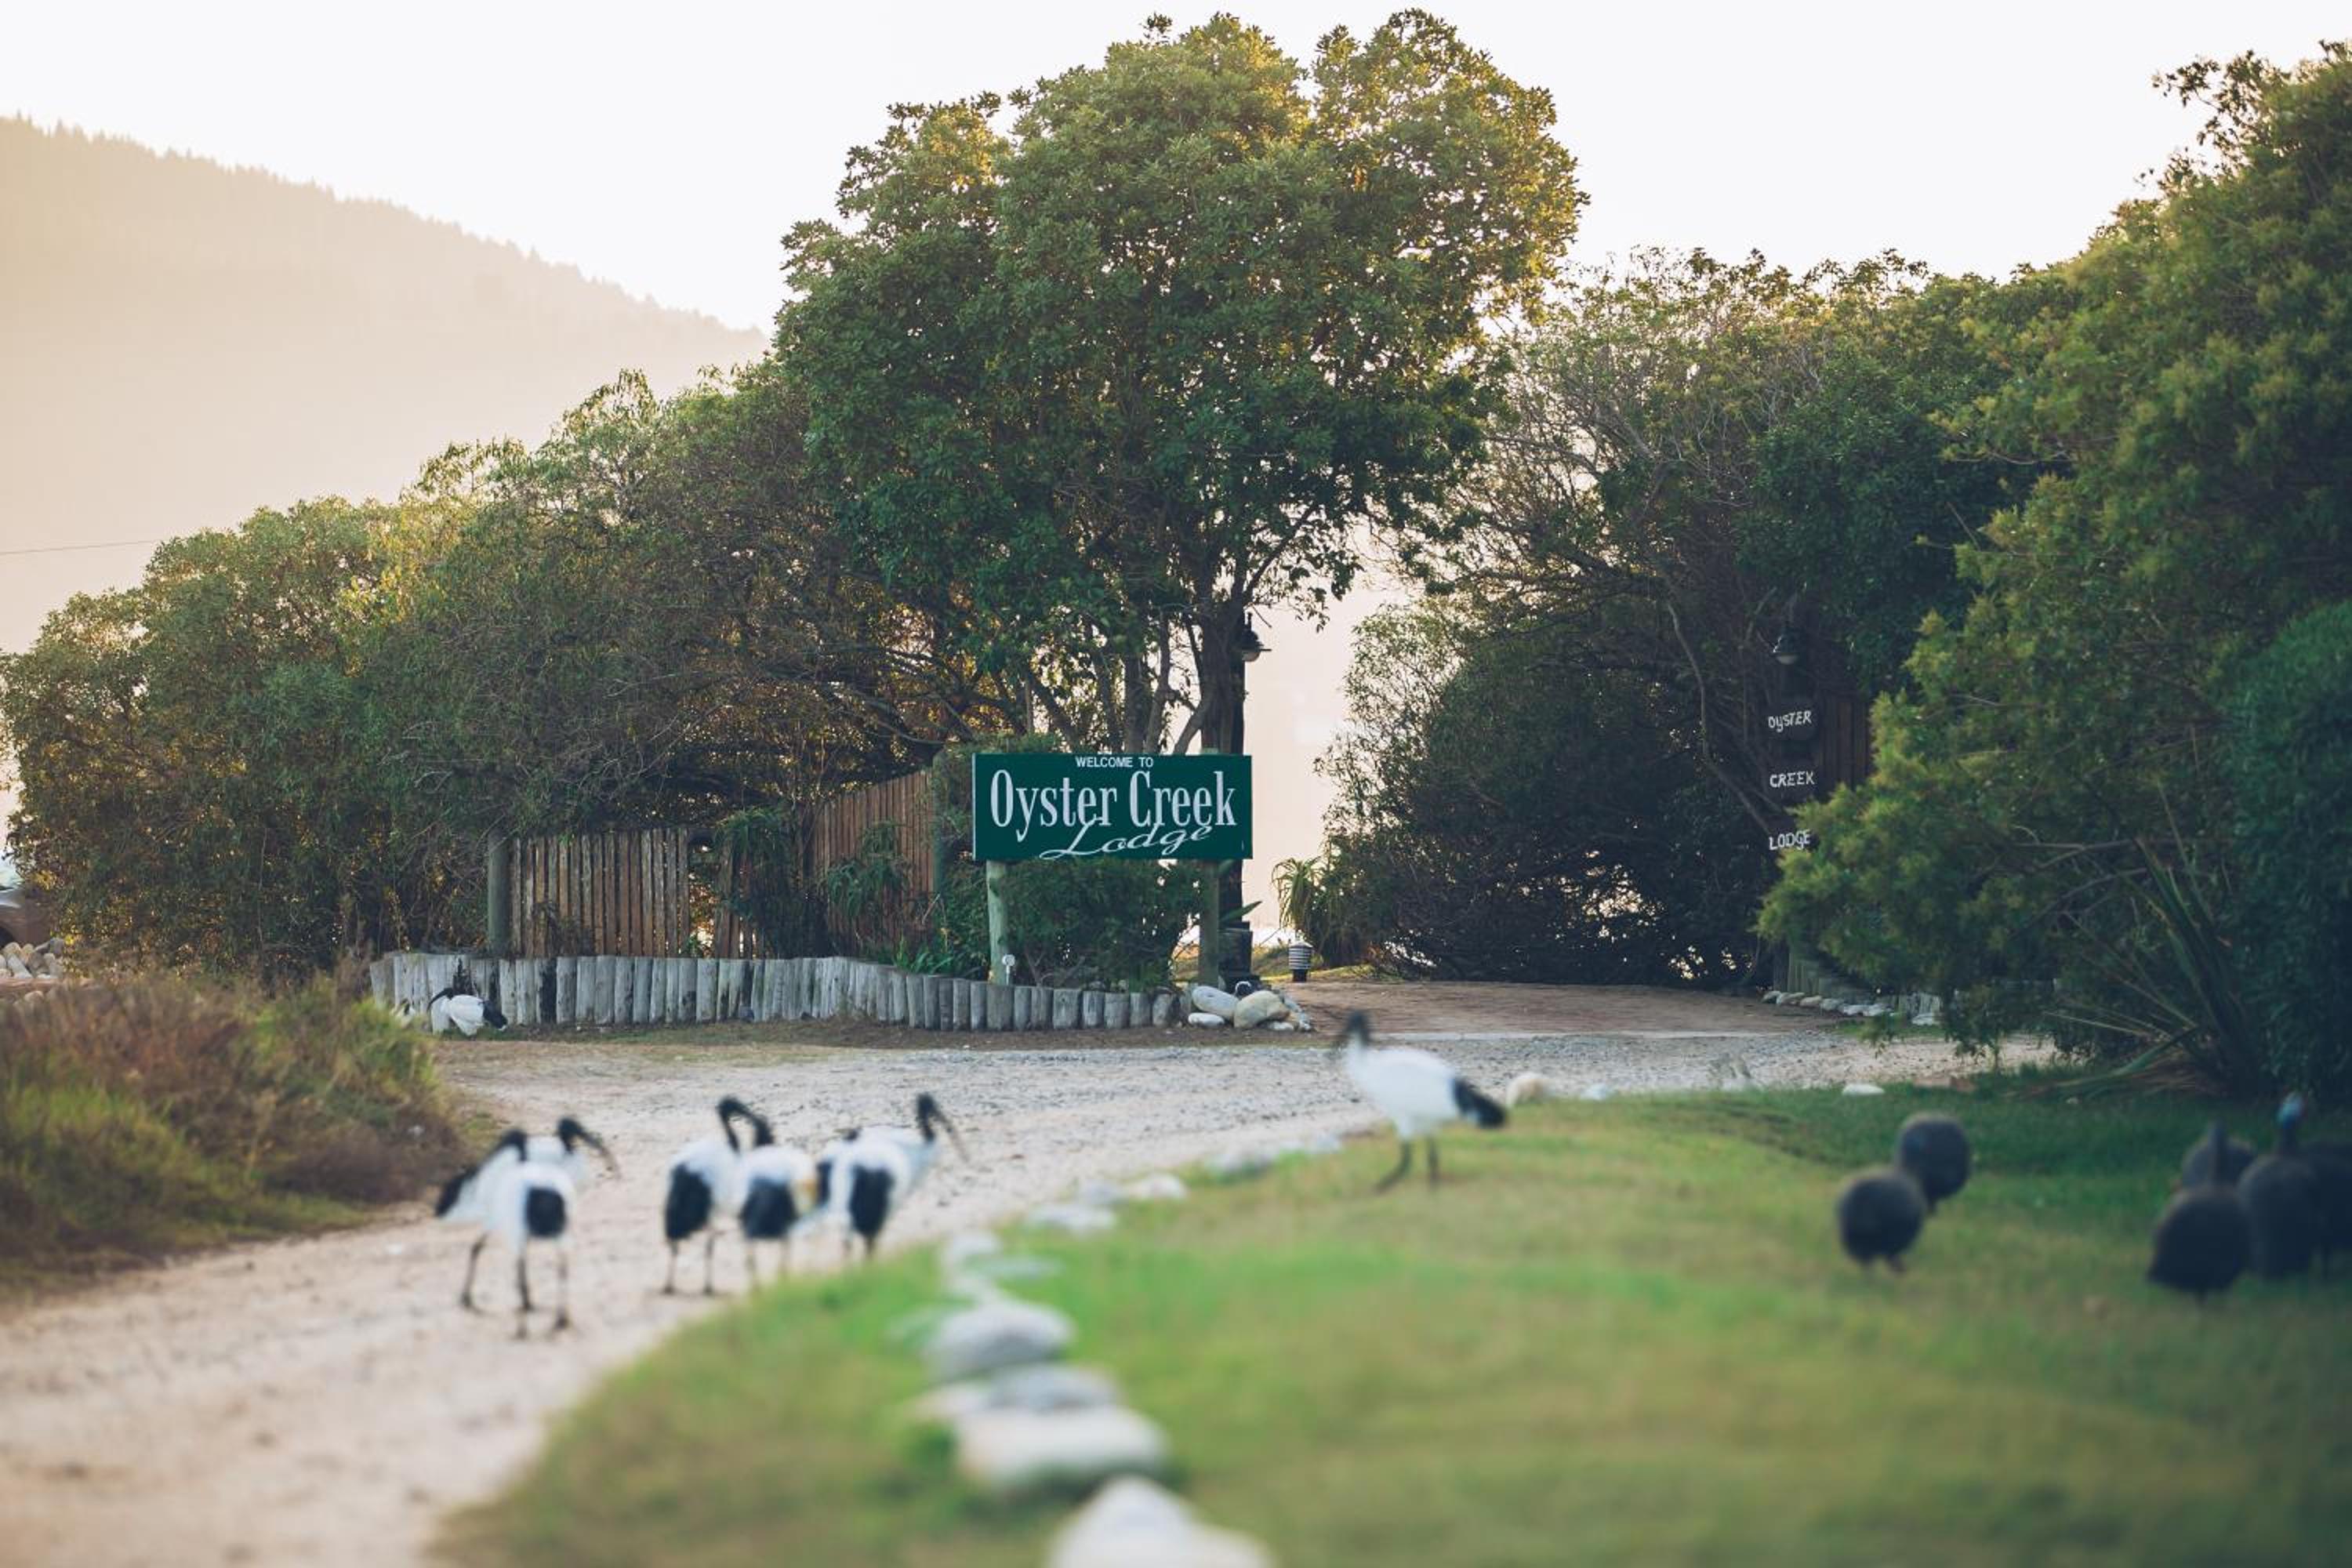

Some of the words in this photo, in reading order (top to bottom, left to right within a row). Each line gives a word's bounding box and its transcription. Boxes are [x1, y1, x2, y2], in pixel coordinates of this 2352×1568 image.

[1076, 757, 1133, 768] WELCOME
[1138, 757, 1154, 768] TO
[1769, 771, 1815, 788] CREEK
[990, 769, 1117, 842] Oyster
[1130, 770, 1237, 827] Creek
[1039, 817, 1213, 859] Lodge
[1769, 829, 1811, 851] LODGE
